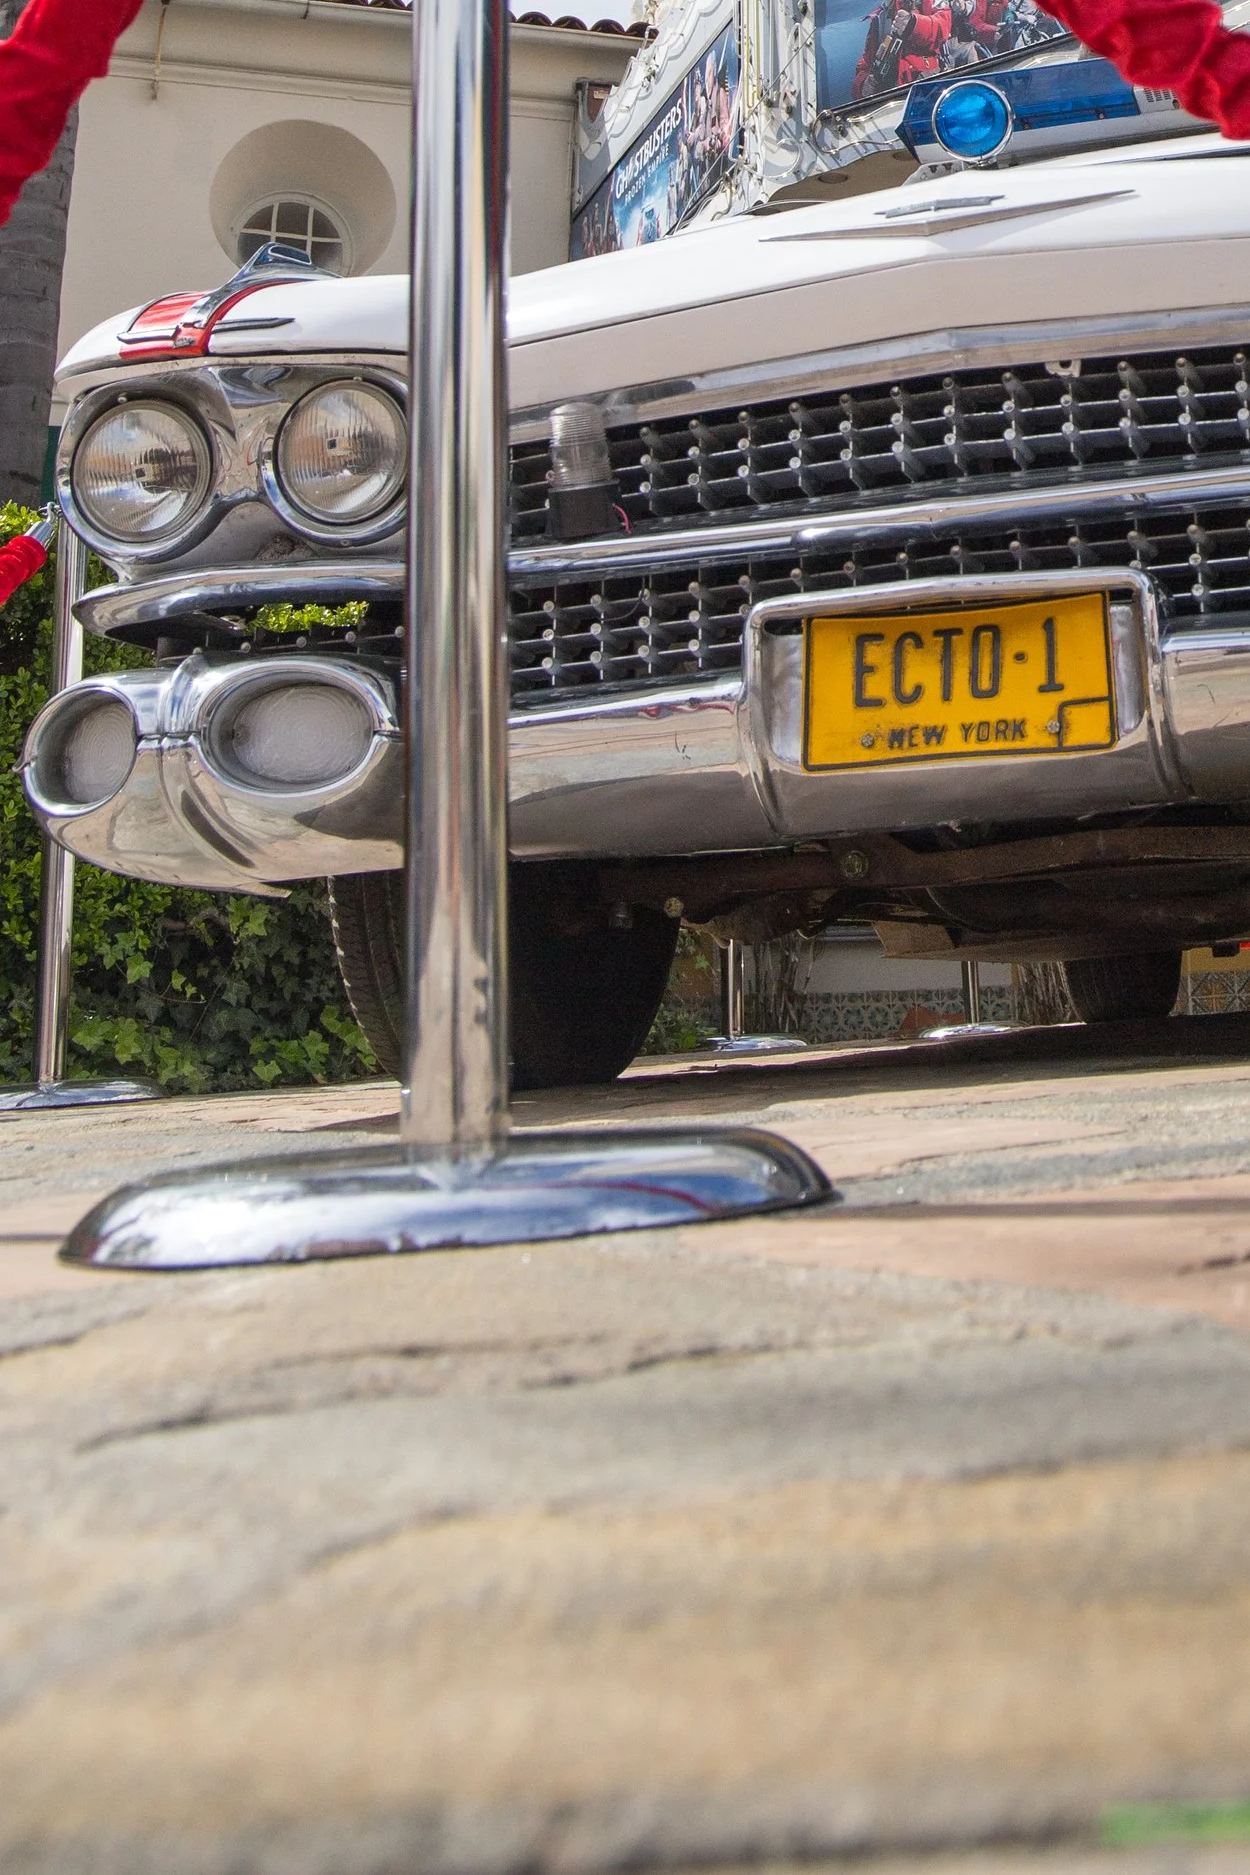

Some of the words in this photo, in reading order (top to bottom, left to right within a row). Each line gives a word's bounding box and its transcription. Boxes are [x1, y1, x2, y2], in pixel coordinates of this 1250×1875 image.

[615, 98, 682, 200] GHOSTBUSTERS
[624, 172, 647, 205] FROZEN
[647, 143, 670, 178] EMPIRE
[887, 724, 946, 749] NEW
[960, 718, 1026, 744] YORK
